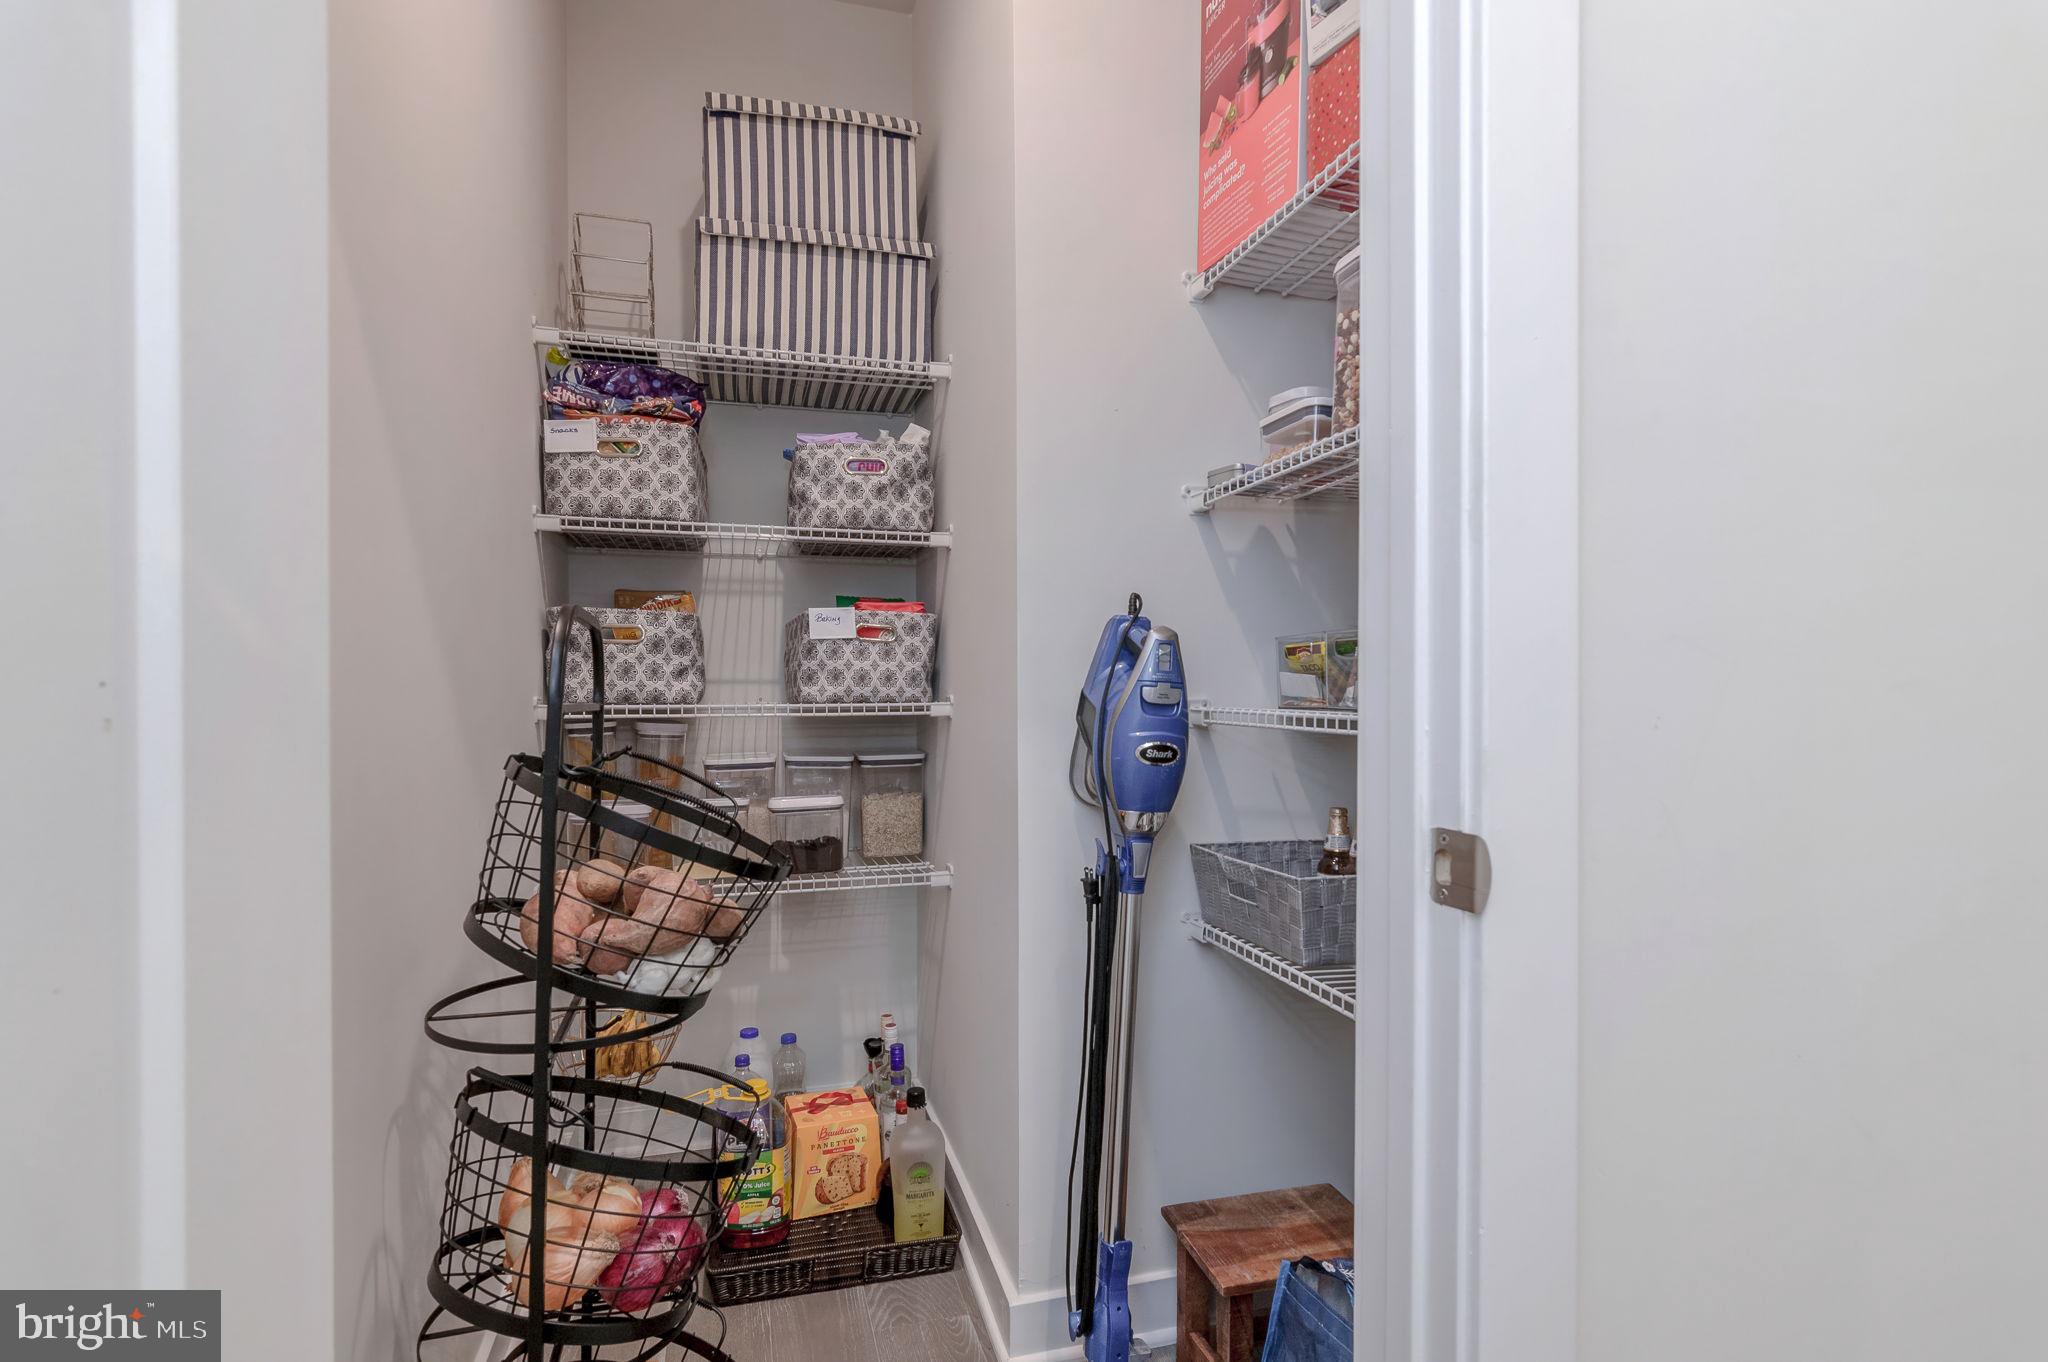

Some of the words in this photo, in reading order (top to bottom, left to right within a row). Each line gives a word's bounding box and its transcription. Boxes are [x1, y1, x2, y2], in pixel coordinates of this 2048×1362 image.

[1218, 145, 1232, 168] said
[1224, 158, 1238, 175] was
[1203, 163, 1246, 210] complicated?
[1146, 749, 1173, 759] Shark
[818, 1126, 859, 1142] Bauducco
[810, 1136, 867, 1151] PANETTONE
